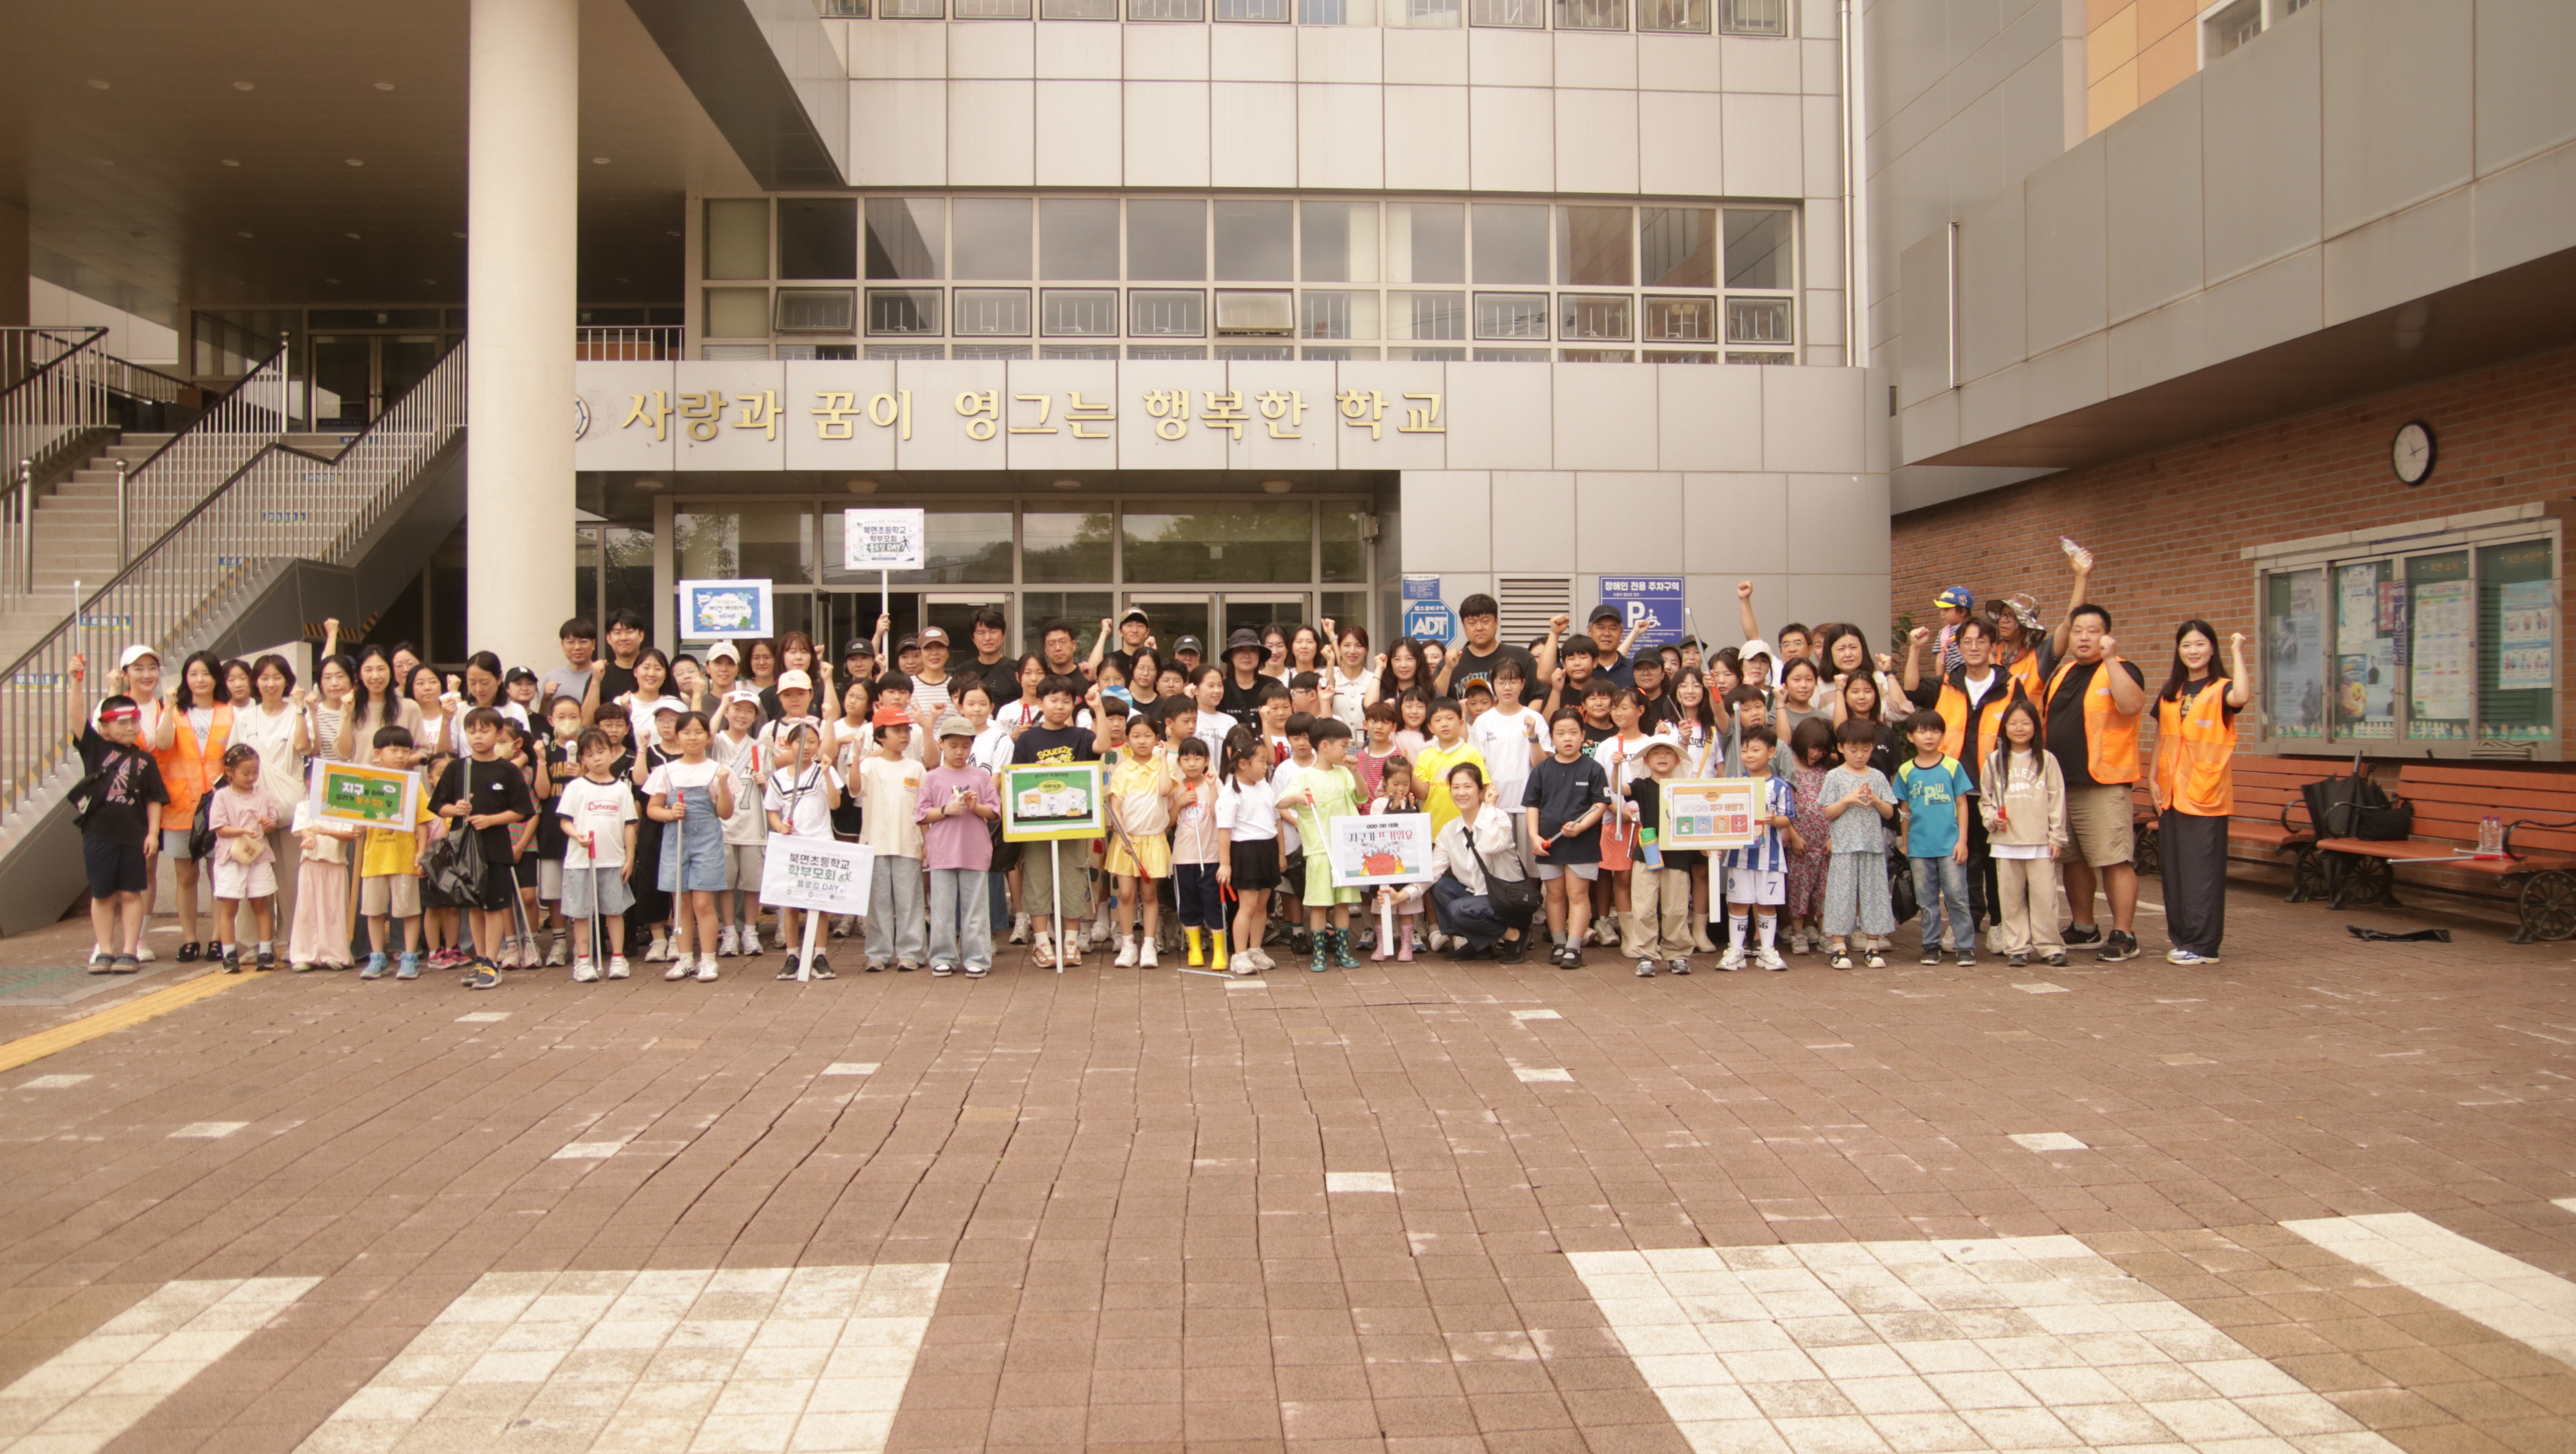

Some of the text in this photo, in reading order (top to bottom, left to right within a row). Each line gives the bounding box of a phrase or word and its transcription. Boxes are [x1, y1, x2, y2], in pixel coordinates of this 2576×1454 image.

[622, 389, 1446, 441] 사랑과 꿈이 영그는 행복한 학교
[1605, 582, 1679, 591] 장애인 전용 주차구역
[1627, 601, 1645, 628] P
[1413, 616, 1447, 635] ADT
[1037, 745, 1074, 760] SQUEEZE
[356, 796, 363, 805] 할
[371, 798, 384, 807] 있는
[1349, 830, 1414, 843] 지구가 뜨거워요
[789, 852, 850, 870] 북면초등학교
[789, 864, 836, 881] 학부모회
[796, 879, 840, 892] 플로깅 DAY
[1768, 881, 1778, 896] 7
